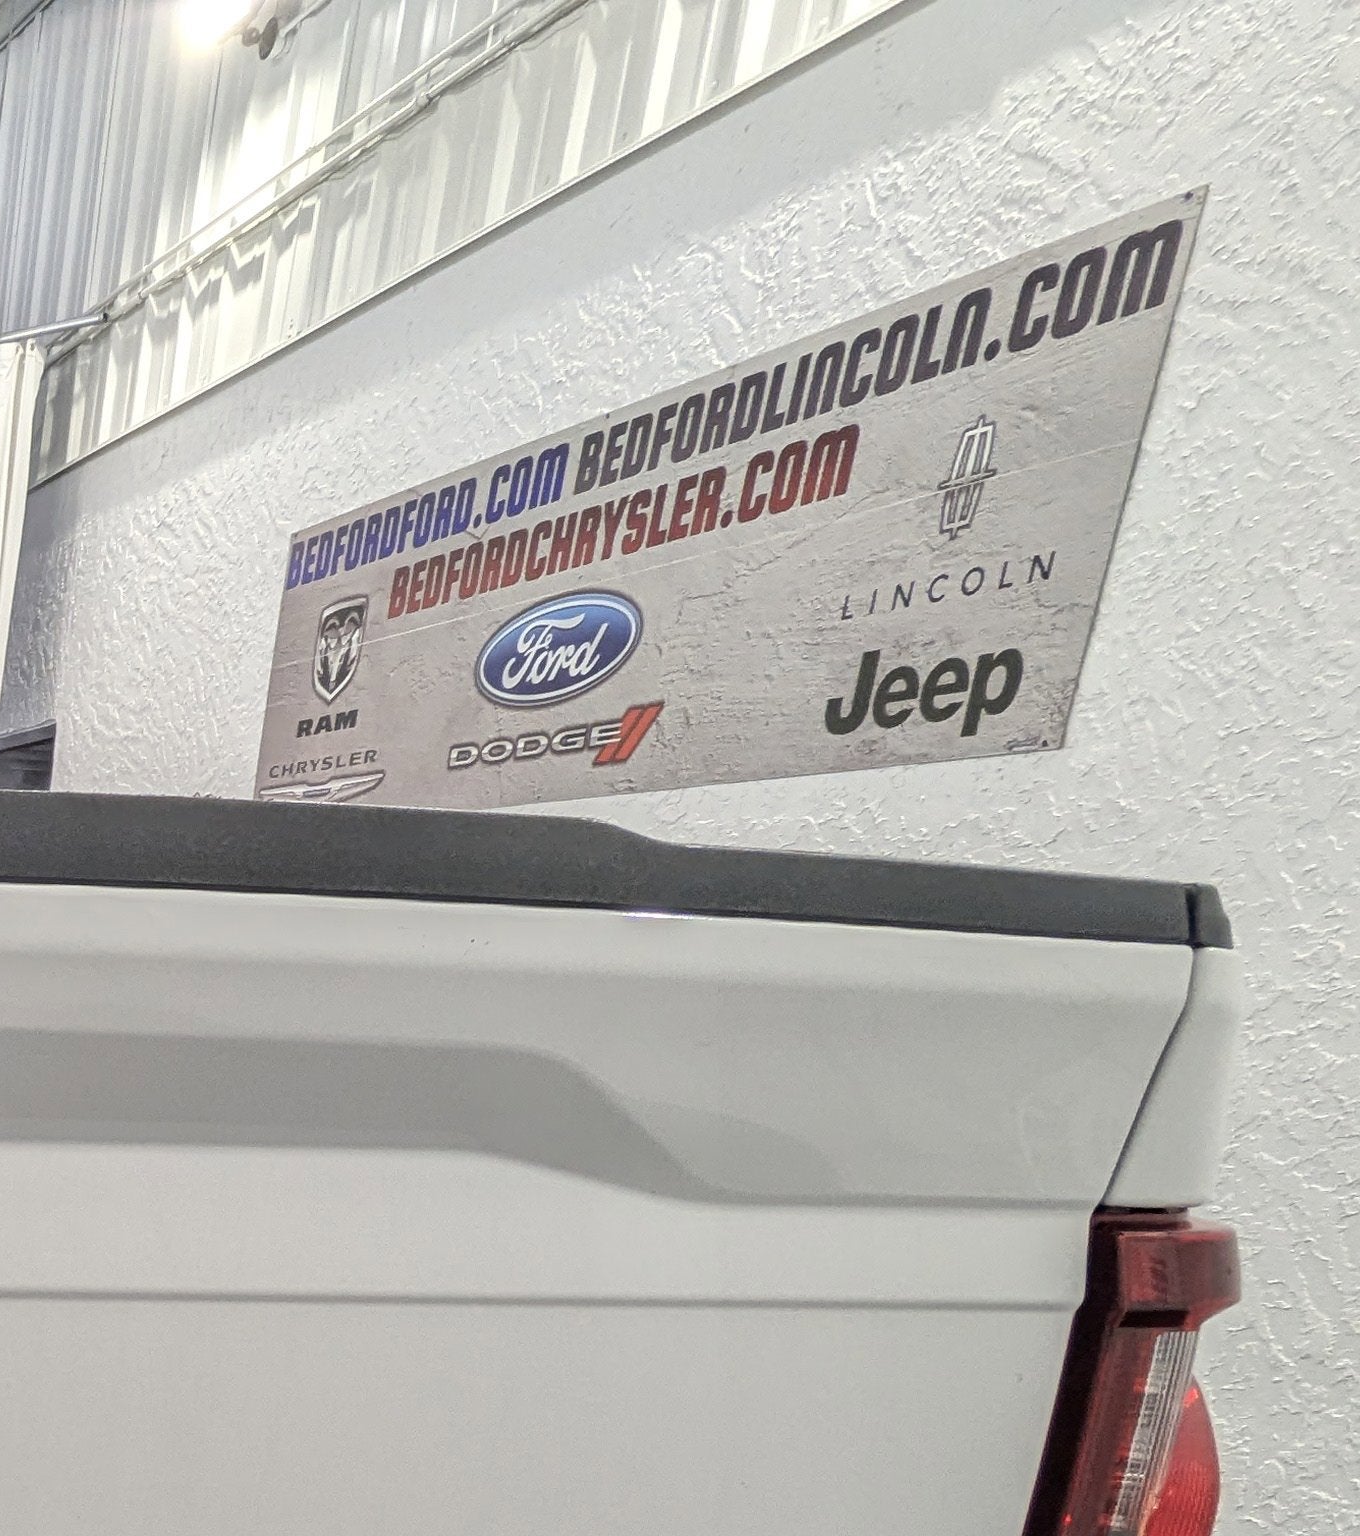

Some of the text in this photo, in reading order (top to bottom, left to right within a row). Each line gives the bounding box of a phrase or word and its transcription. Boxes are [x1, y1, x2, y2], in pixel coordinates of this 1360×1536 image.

[286, 219, 1184, 591] BEDFORDFORD.COM BEDFORDLINCOLN.COM
[387, 423, 860, 620] BEDFORDCHRYSLER.COM
[840, 550, 1058, 622] LINCOLN
[501, 611, 610, 690] Ford
[295, 708, 359, 739] RAM
[824, 643, 1024, 738] Jeep
[268, 749, 378, 779] CHRYSLER
[447, 720, 623, 771] DODGE
